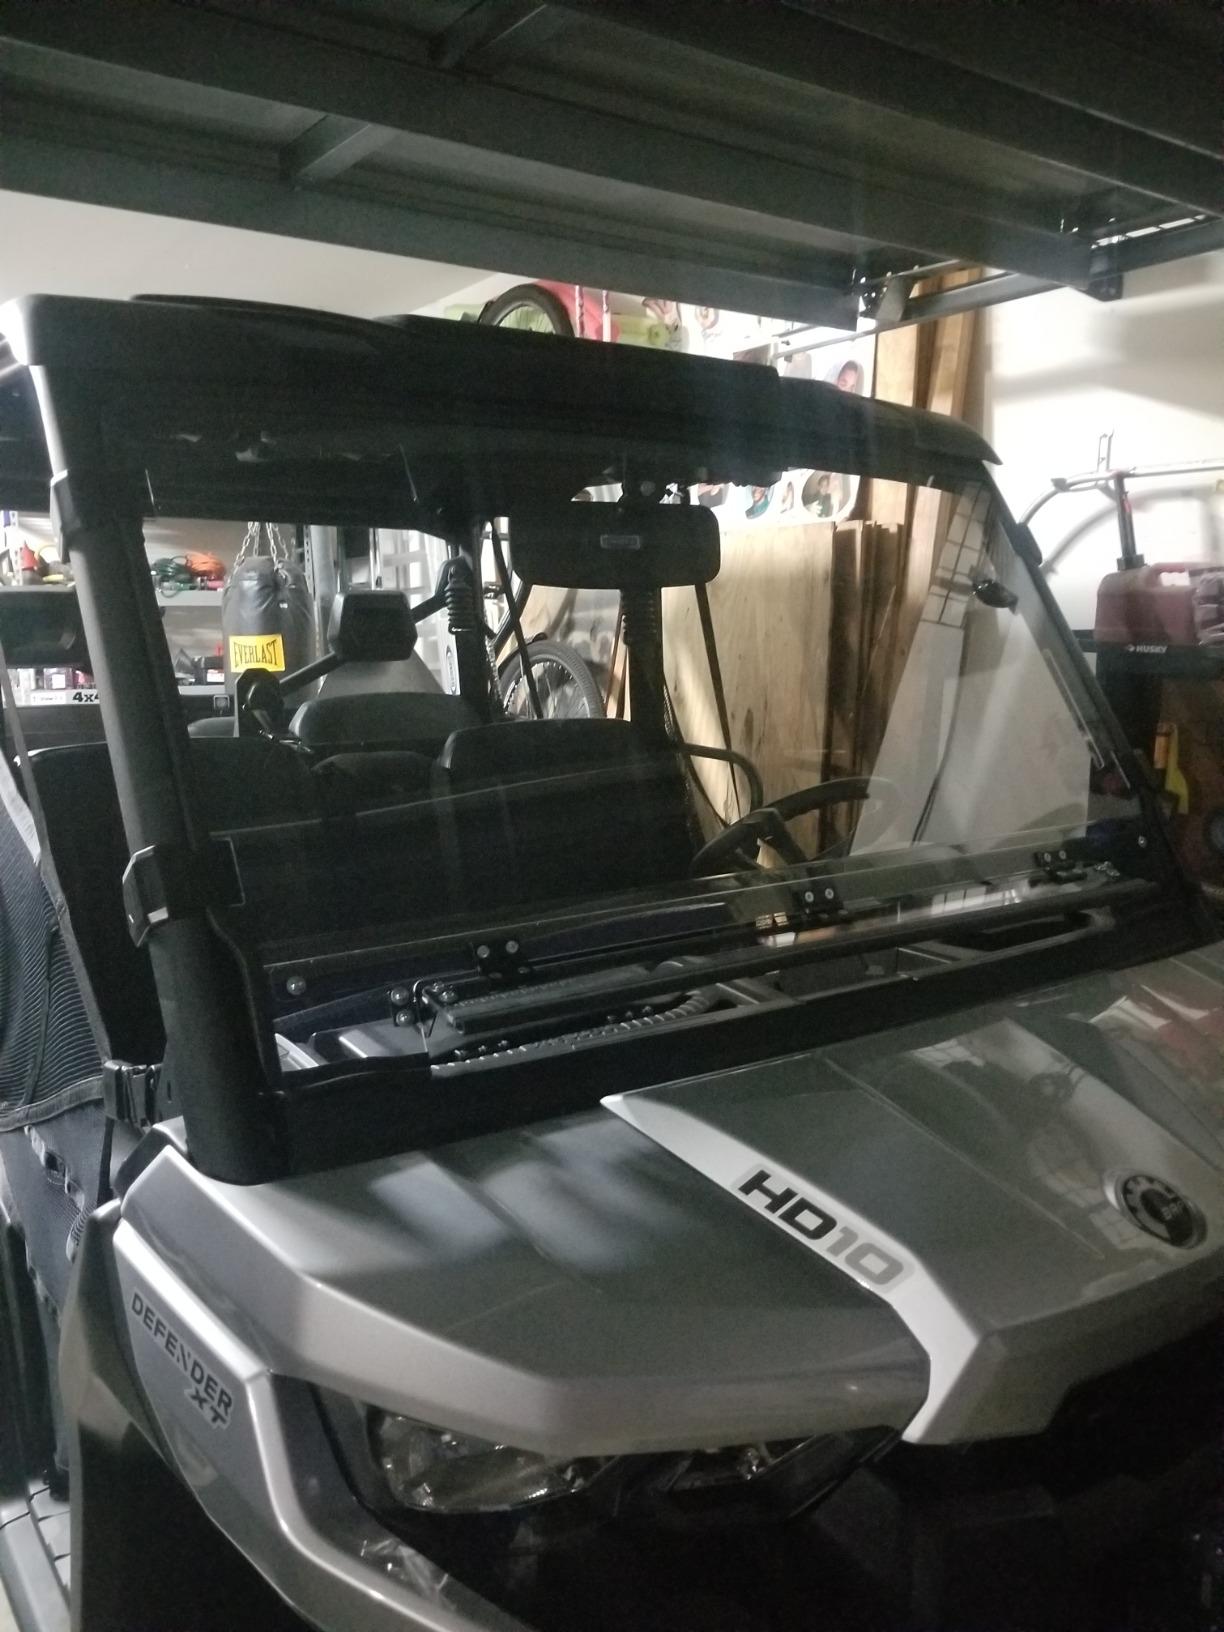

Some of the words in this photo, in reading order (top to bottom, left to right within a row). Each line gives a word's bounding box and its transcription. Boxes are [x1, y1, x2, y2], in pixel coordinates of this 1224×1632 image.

[233, 638, 278, 668] EVERLAST
[1136, 645, 1168, 654] HUSKY
[738, 1169, 904, 1285] HD10
[131, 1292, 232, 1416] DEFENDER
[190, 1387, 227, 1424] XT
